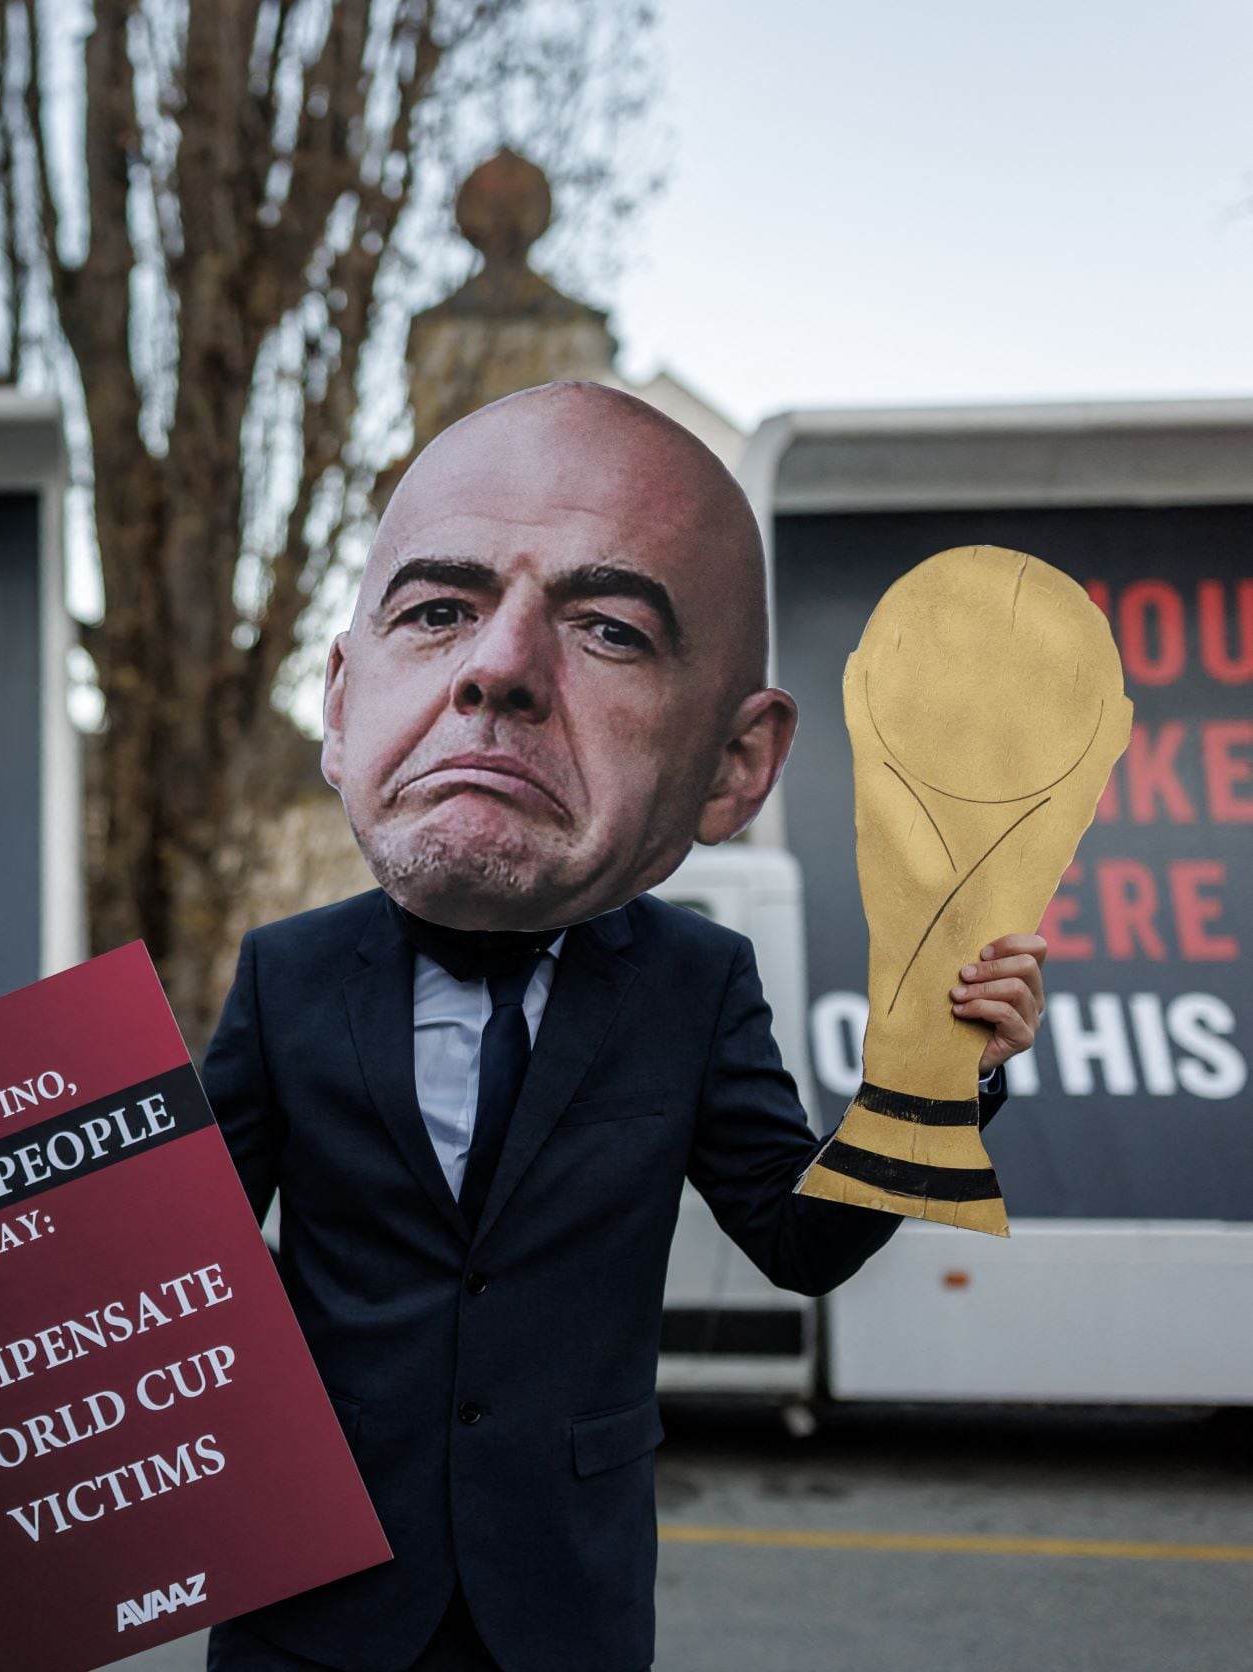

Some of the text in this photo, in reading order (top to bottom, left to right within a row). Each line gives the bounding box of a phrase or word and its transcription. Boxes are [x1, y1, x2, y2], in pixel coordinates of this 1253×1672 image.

[1083, 577, 1253, 688] OU
[1037, 858, 1240, 962] ERE
[135, 1344, 237, 1412] CUP
[6, 1433, 227, 1543] VICTIMS
[116, 1571, 208, 1633] AVAAZ
